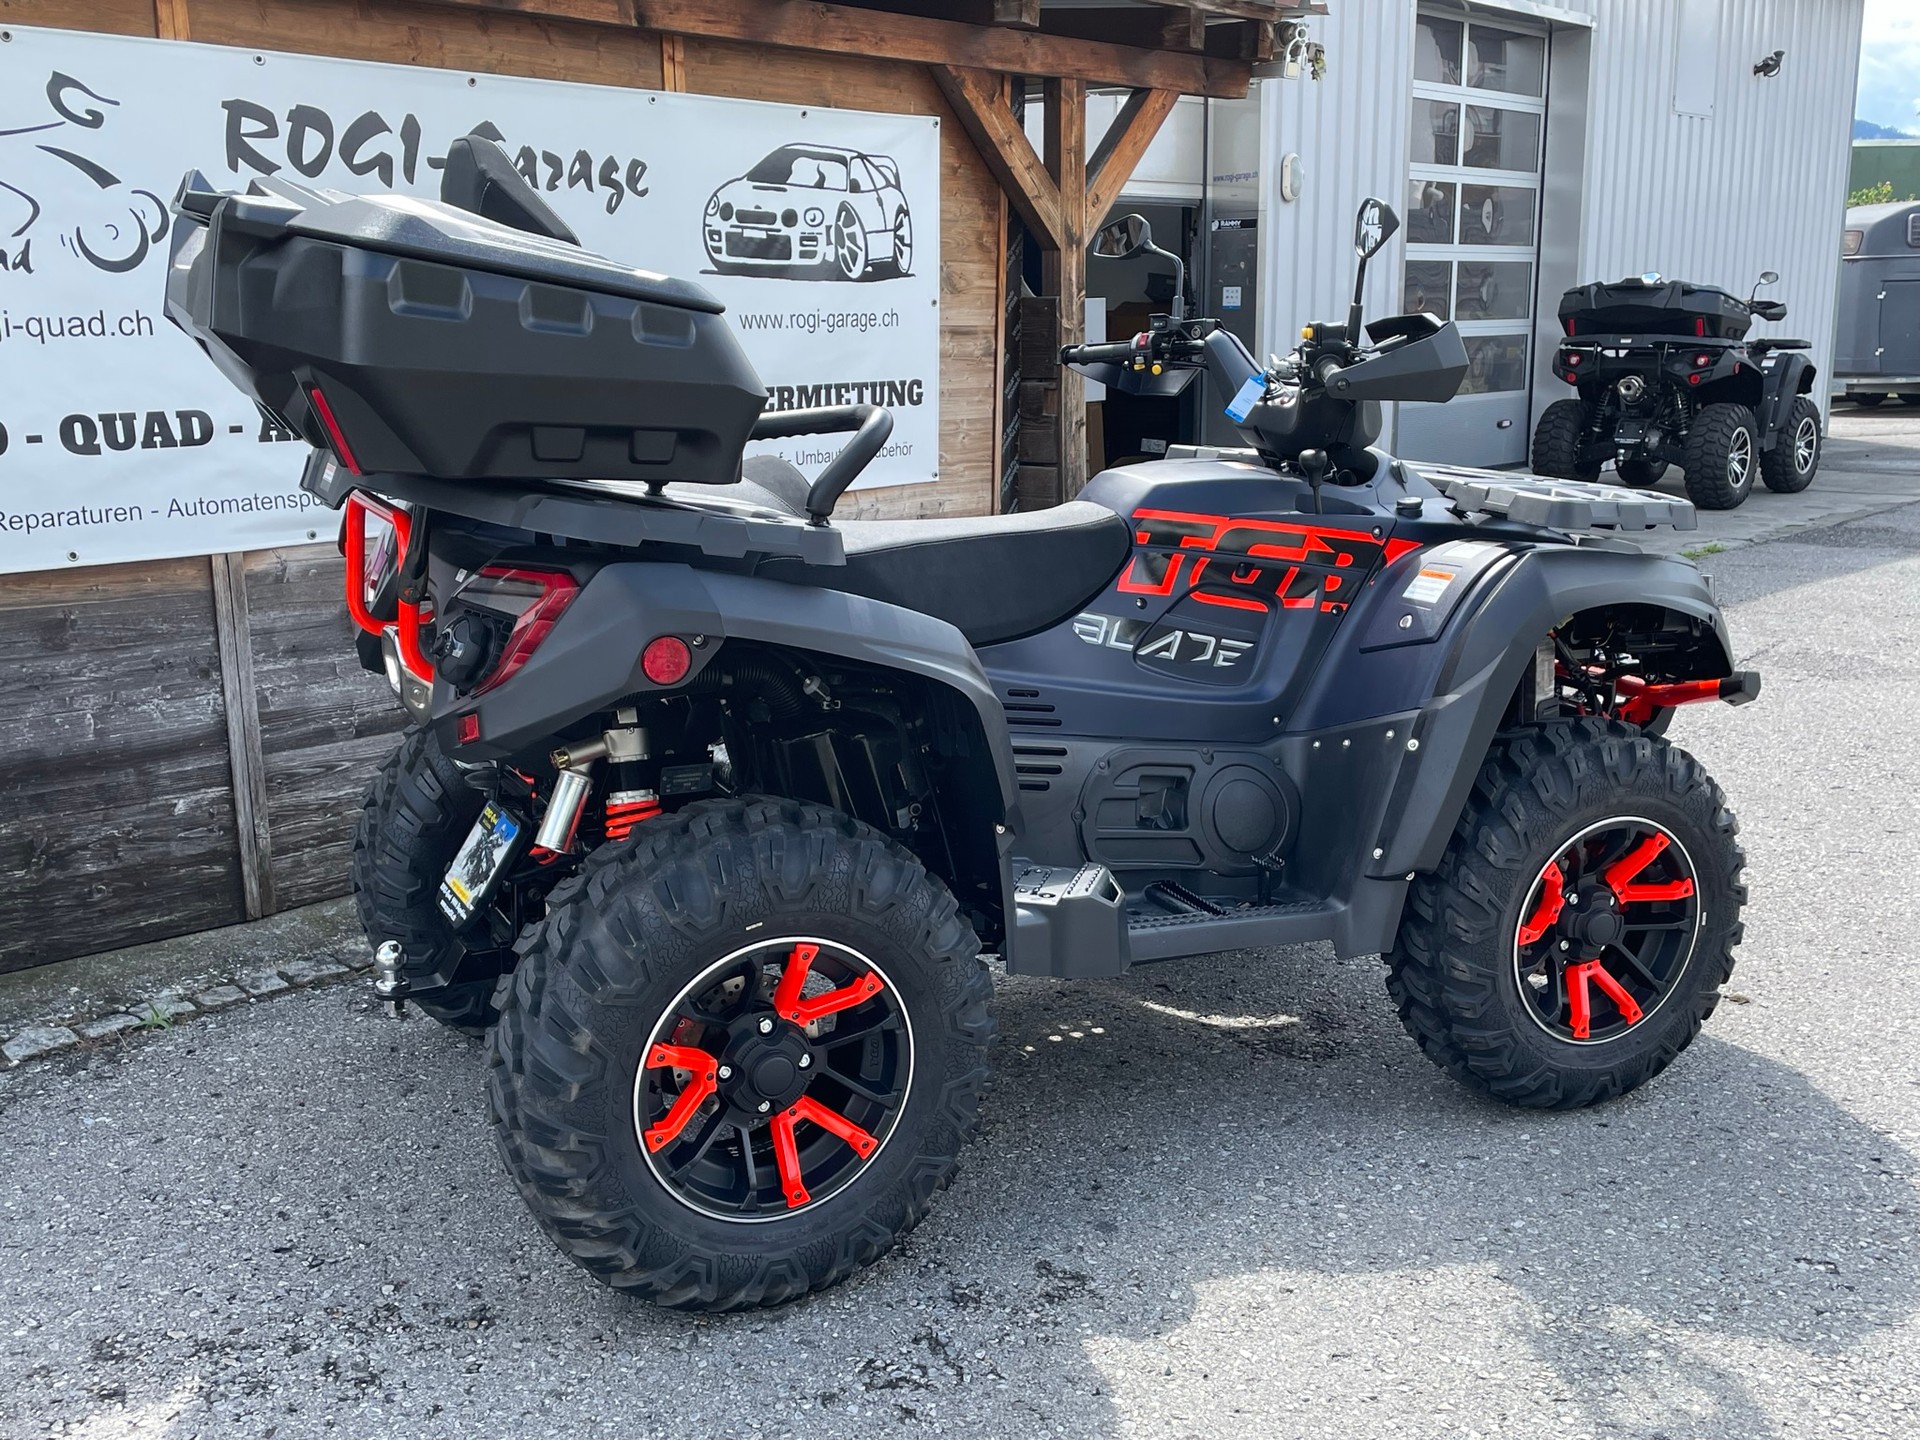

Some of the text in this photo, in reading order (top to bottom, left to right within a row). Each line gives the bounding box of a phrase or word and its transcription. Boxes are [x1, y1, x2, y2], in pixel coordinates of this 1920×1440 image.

[739, 308, 899, 334] www.rogi-garage.ch
[59, 410, 214, 455] QUAD
[1072, 612, 1255, 668] BLADE
